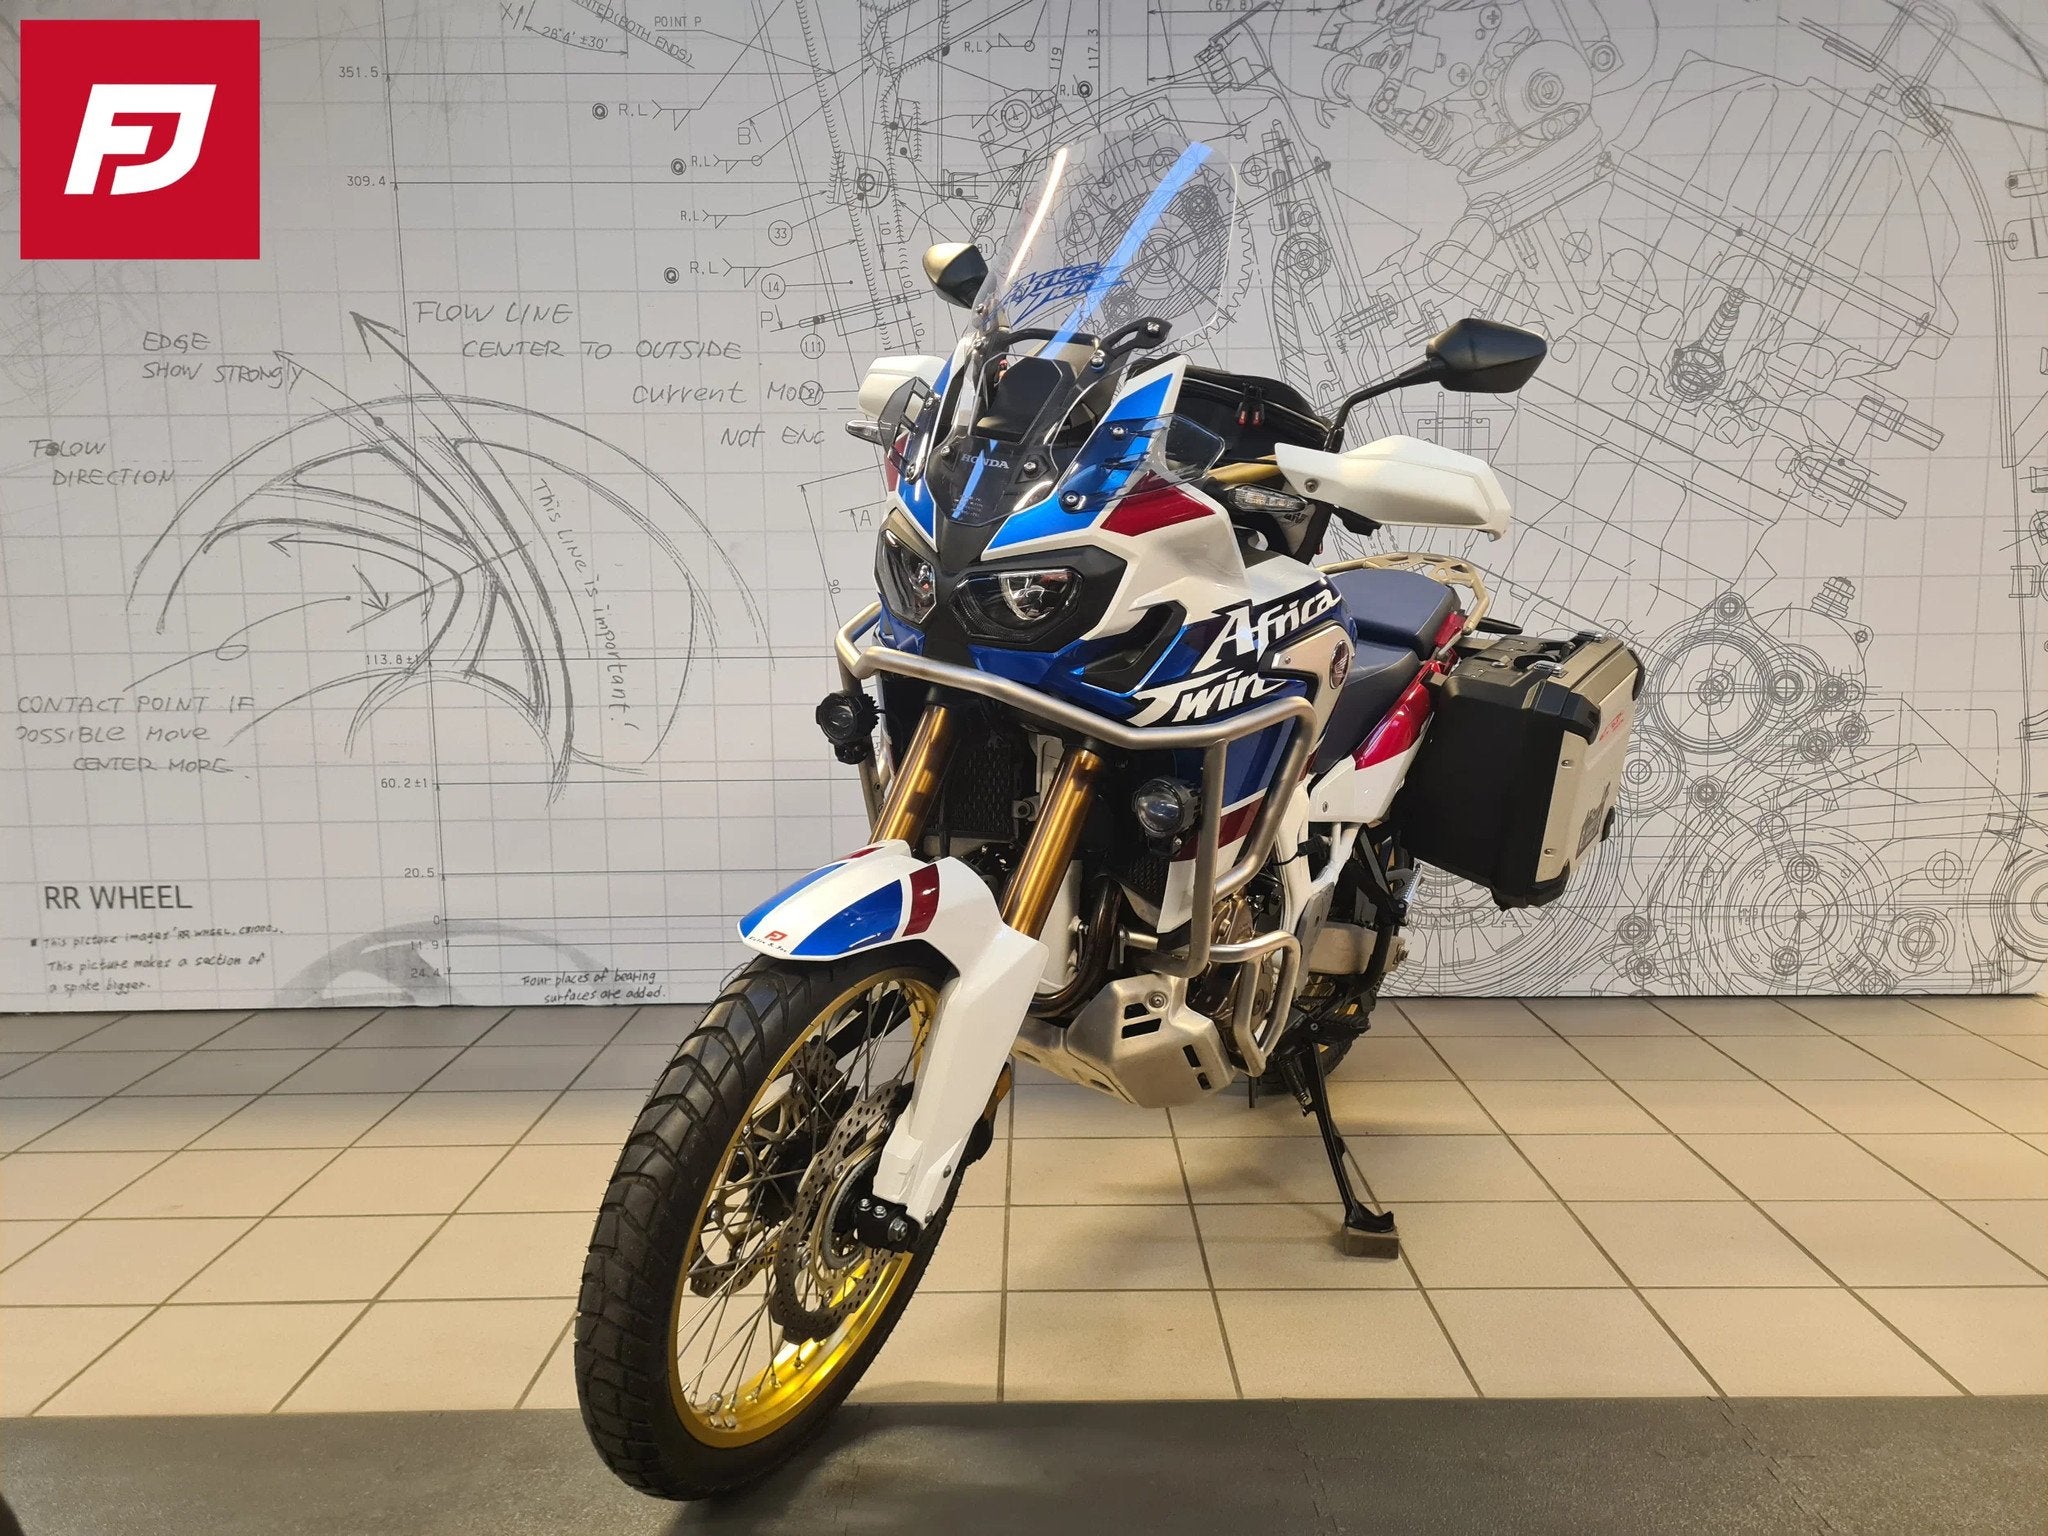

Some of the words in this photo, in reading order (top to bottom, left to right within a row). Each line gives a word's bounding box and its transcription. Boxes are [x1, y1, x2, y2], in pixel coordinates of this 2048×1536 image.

[653, 15, 688, 28] POINT
[694, 15, 702, 28] P
[338, 66, 379, 78] 351.5
[737, 126, 751, 145] B
[346, 175, 386, 187] 309.4
[774, 227, 788, 239] 33
[767, 281, 780, 292] 14
[412, 300, 495, 325] FLOW
[505, 302, 573, 324] LINE
[760, 311, 774, 328] P
[142, 331, 211, 353] EDGE
[462, 340, 565, 358] CENTER
[581, 341, 612, 359] TO
[635, 340, 743, 359] OUTSIDE
[142, 361, 204, 381] SHOW
[52, 469, 176, 488] DIRECTION
[859, 509, 872, 527] A
[1191, 588, 1343, 674] Africa
[138, 695, 210, 713] POINT
[229, 696, 256, 713] IF
[1126, 667, 1290, 728] Twin
[73, 757, 158, 773] CENTER
[404, 867, 435, 878] 20.5
[44, 885, 81, 909] RR
[89, 885, 193, 909] WHEEL
[48, 959, 74, 972] This
[79, 958, 128, 975] picture
[195, 953, 241, 966] section
[248, 952, 266, 966] of
[521, 975, 552, 987] Four
[555, 971, 590, 988] places
[594, 967, 609, 983] of
[614, 967, 656, 985] bearing
[544, 988, 596, 1004] surfaces
[600, 989, 621, 999] are
[625, 985, 666, 998] added.
